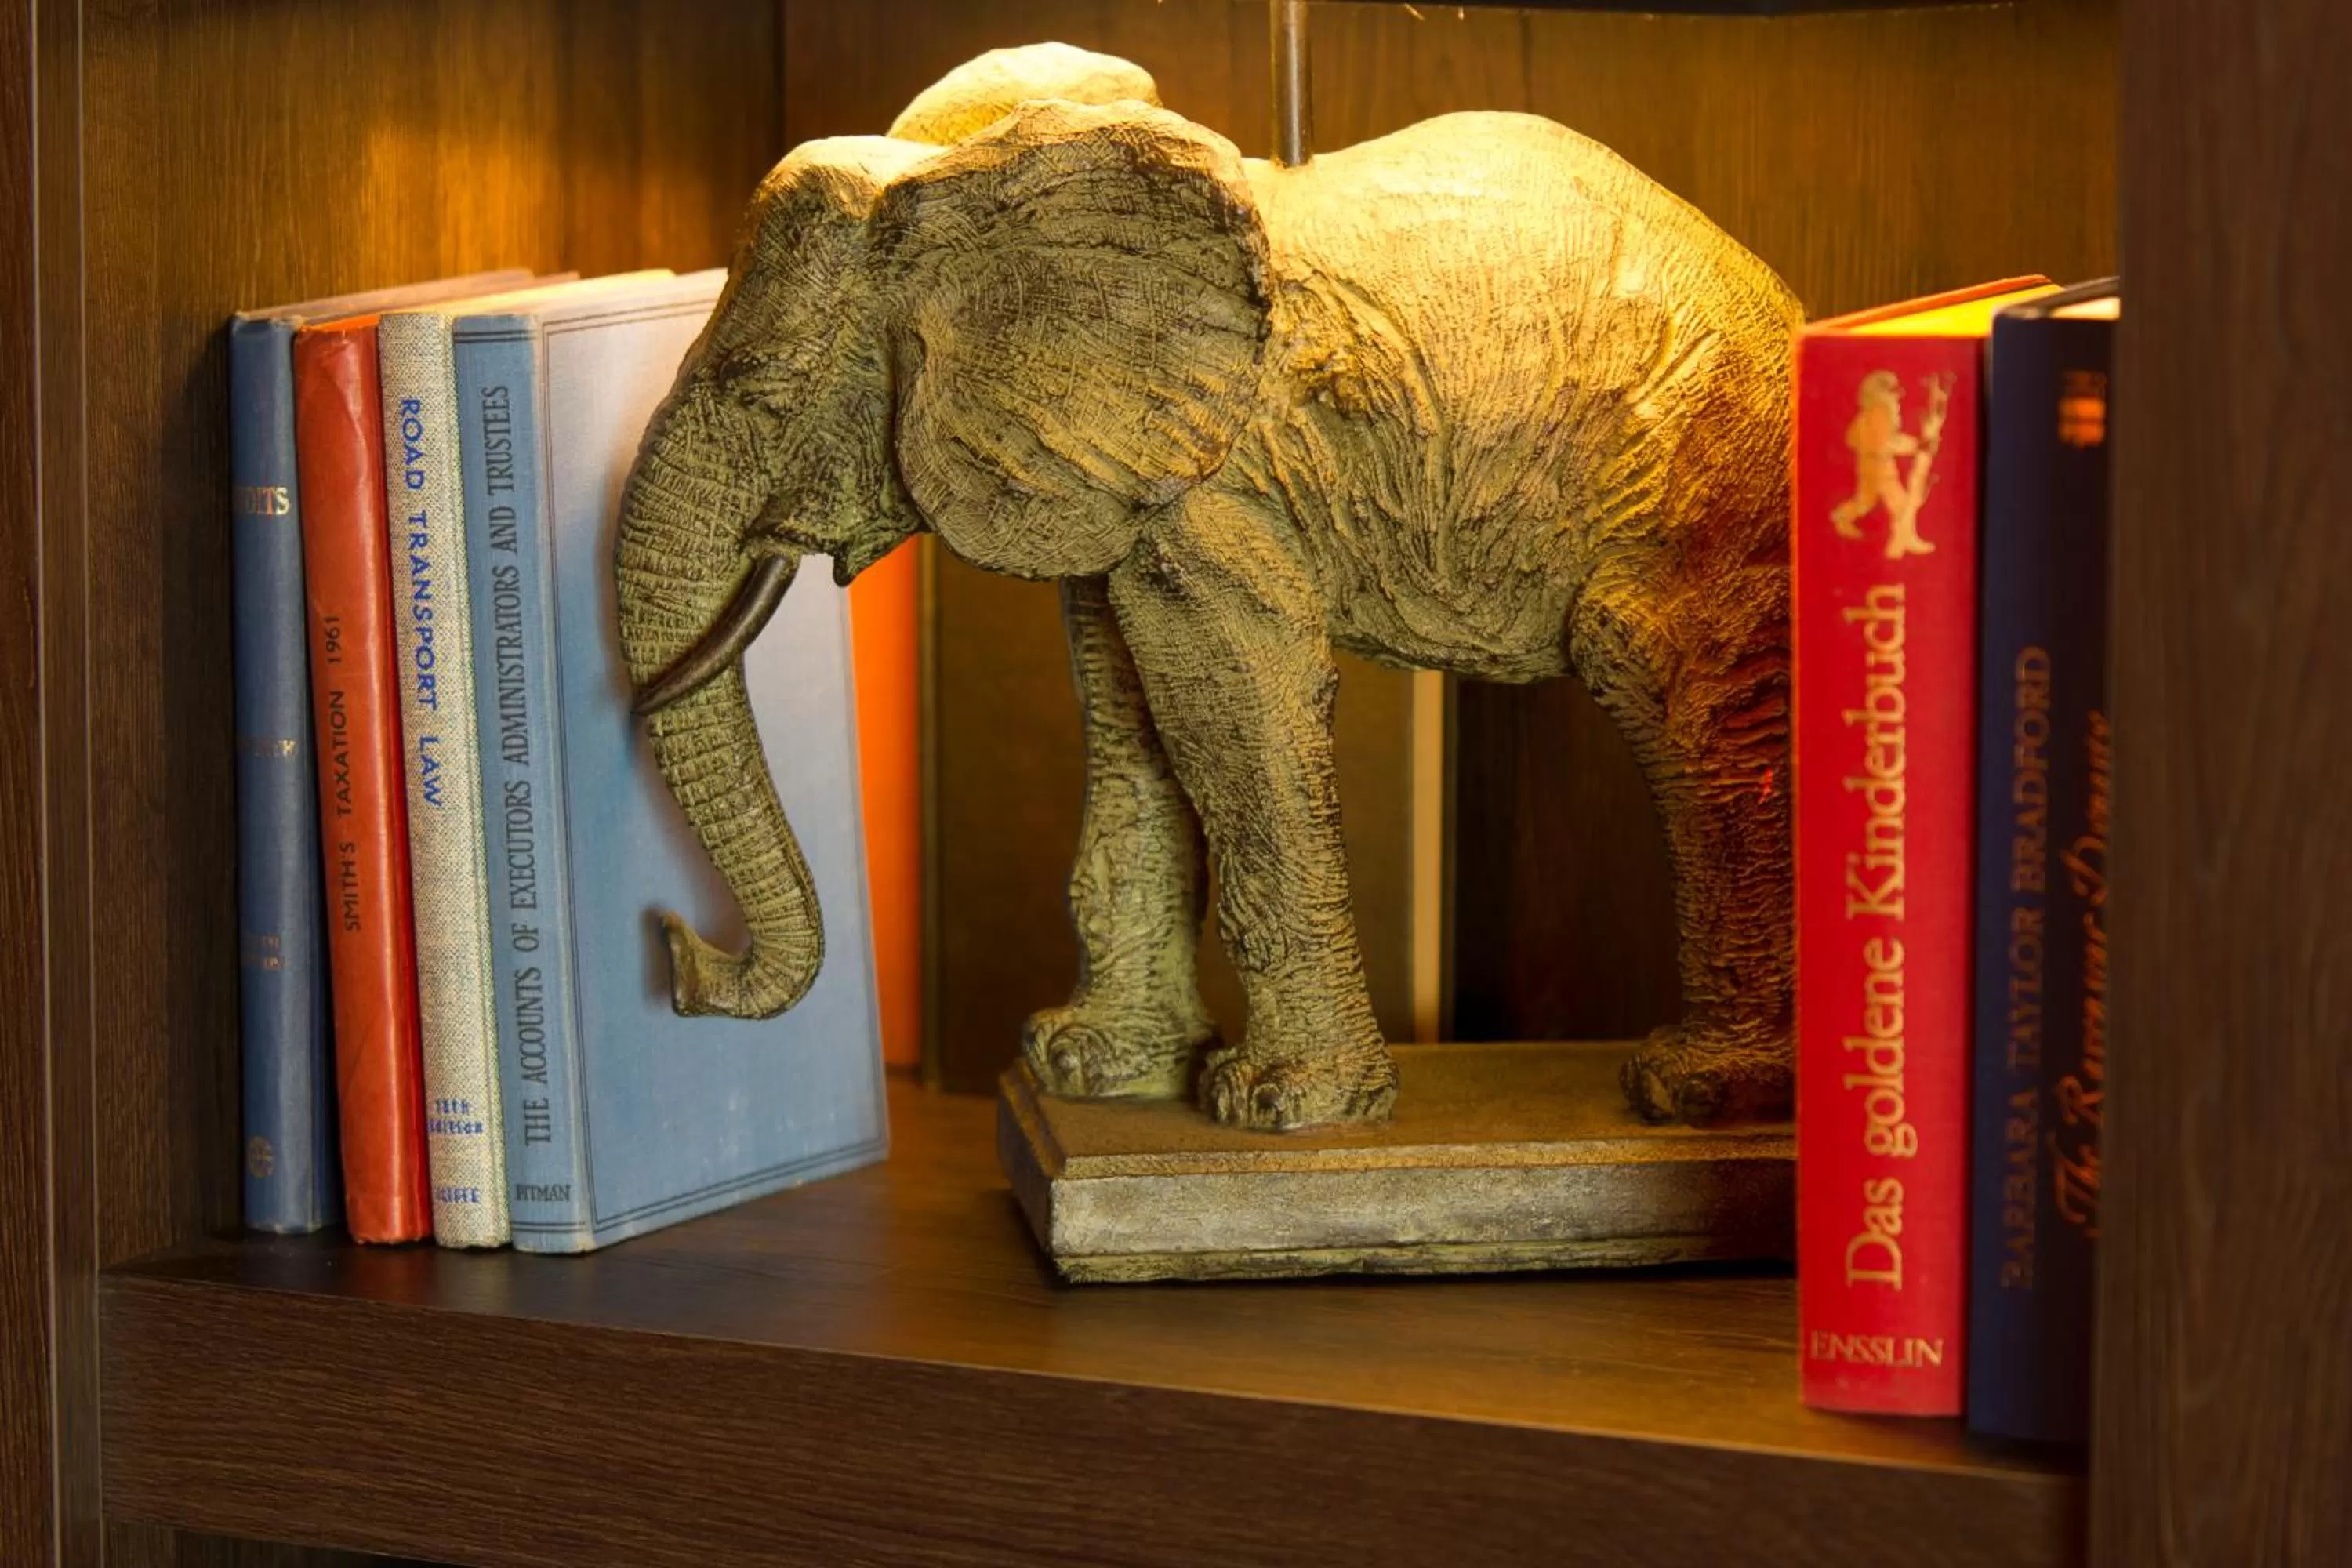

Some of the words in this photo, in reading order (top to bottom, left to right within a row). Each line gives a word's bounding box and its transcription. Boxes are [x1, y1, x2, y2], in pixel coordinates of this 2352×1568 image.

[401, 398, 423, 491] ROAD
[481, 385, 512, 496] TRUSTEES
[490, 506, 517, 553] AND
[327, 615, 344, 663] 1961
[408, 510, 437, 709] TRANSPORT
[492, 565, 528, 766] ADMINISTRATORS
[328, 690, 354, 818] TAXATION
[419, 736, 441, 807] LAW
[1843, 583, 1906, 923] Kinderbuch
[2013, 644, 2052, 894] BRADFORD
[339, 841, 360, 932] SMITH'S
[504, 780, 536, 909] EXECUTORS
[513, 922, 539, 953] OF
[2007, 906, 2045, 1069] TAYLOR
[514, 966, 548, 1085] ACCOUNTS
[1843, 938, 1918, 1158] goldene
[524, 1098, 552, 1146] THE
[516, 1184, 570, 1202] PITMAN
[1845, 1178, 1904, 1291] Das
[2002, 1088, 2038, 1289] BARBARA
[1810, 1330, 1943, 1367] ENSSLIN
